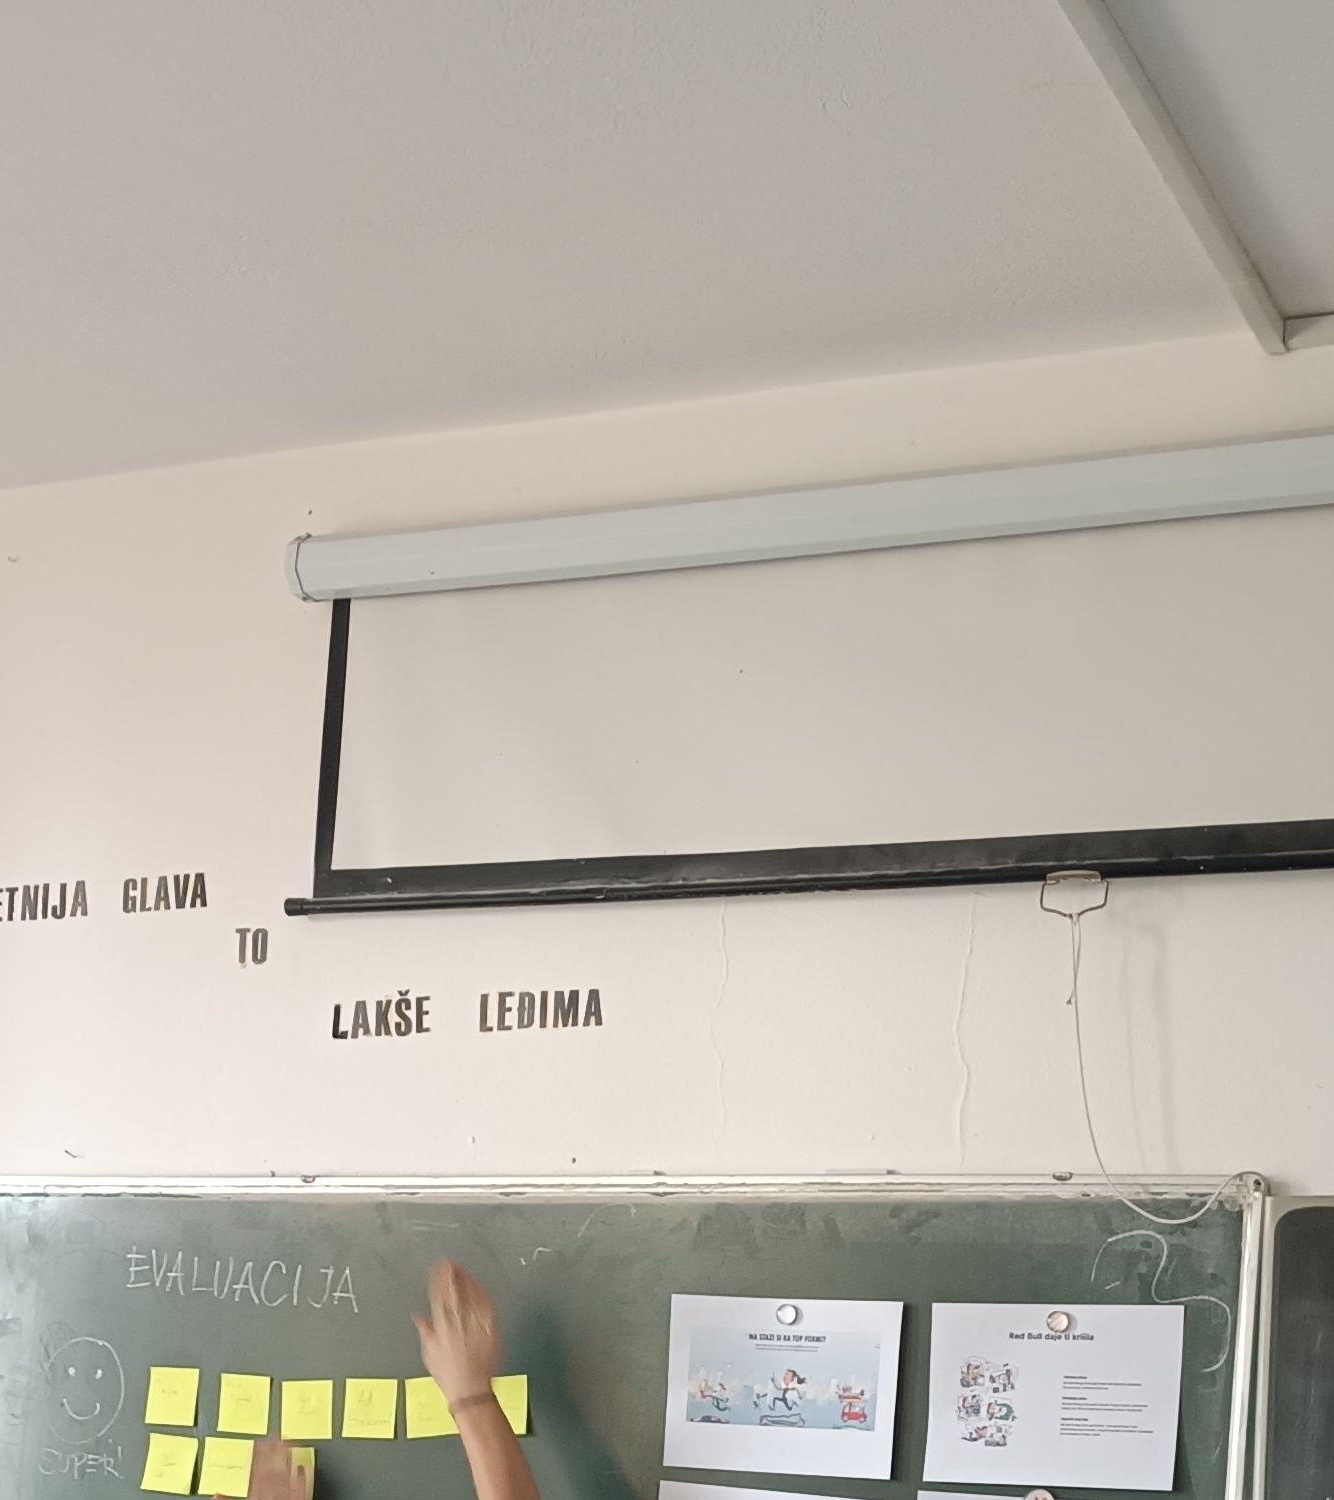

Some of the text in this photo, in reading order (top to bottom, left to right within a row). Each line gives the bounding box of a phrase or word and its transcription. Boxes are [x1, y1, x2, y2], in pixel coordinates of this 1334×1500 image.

[121, 872, 208, 914] GLAVA
[235, 926, 269, 966] TO
[331, 988, 604, 1041] LAKŠE LEĐIMA
[125, 1245, 359, 1313] EVALUACIJA
[1009, 1332, 1025, 1340] Red
